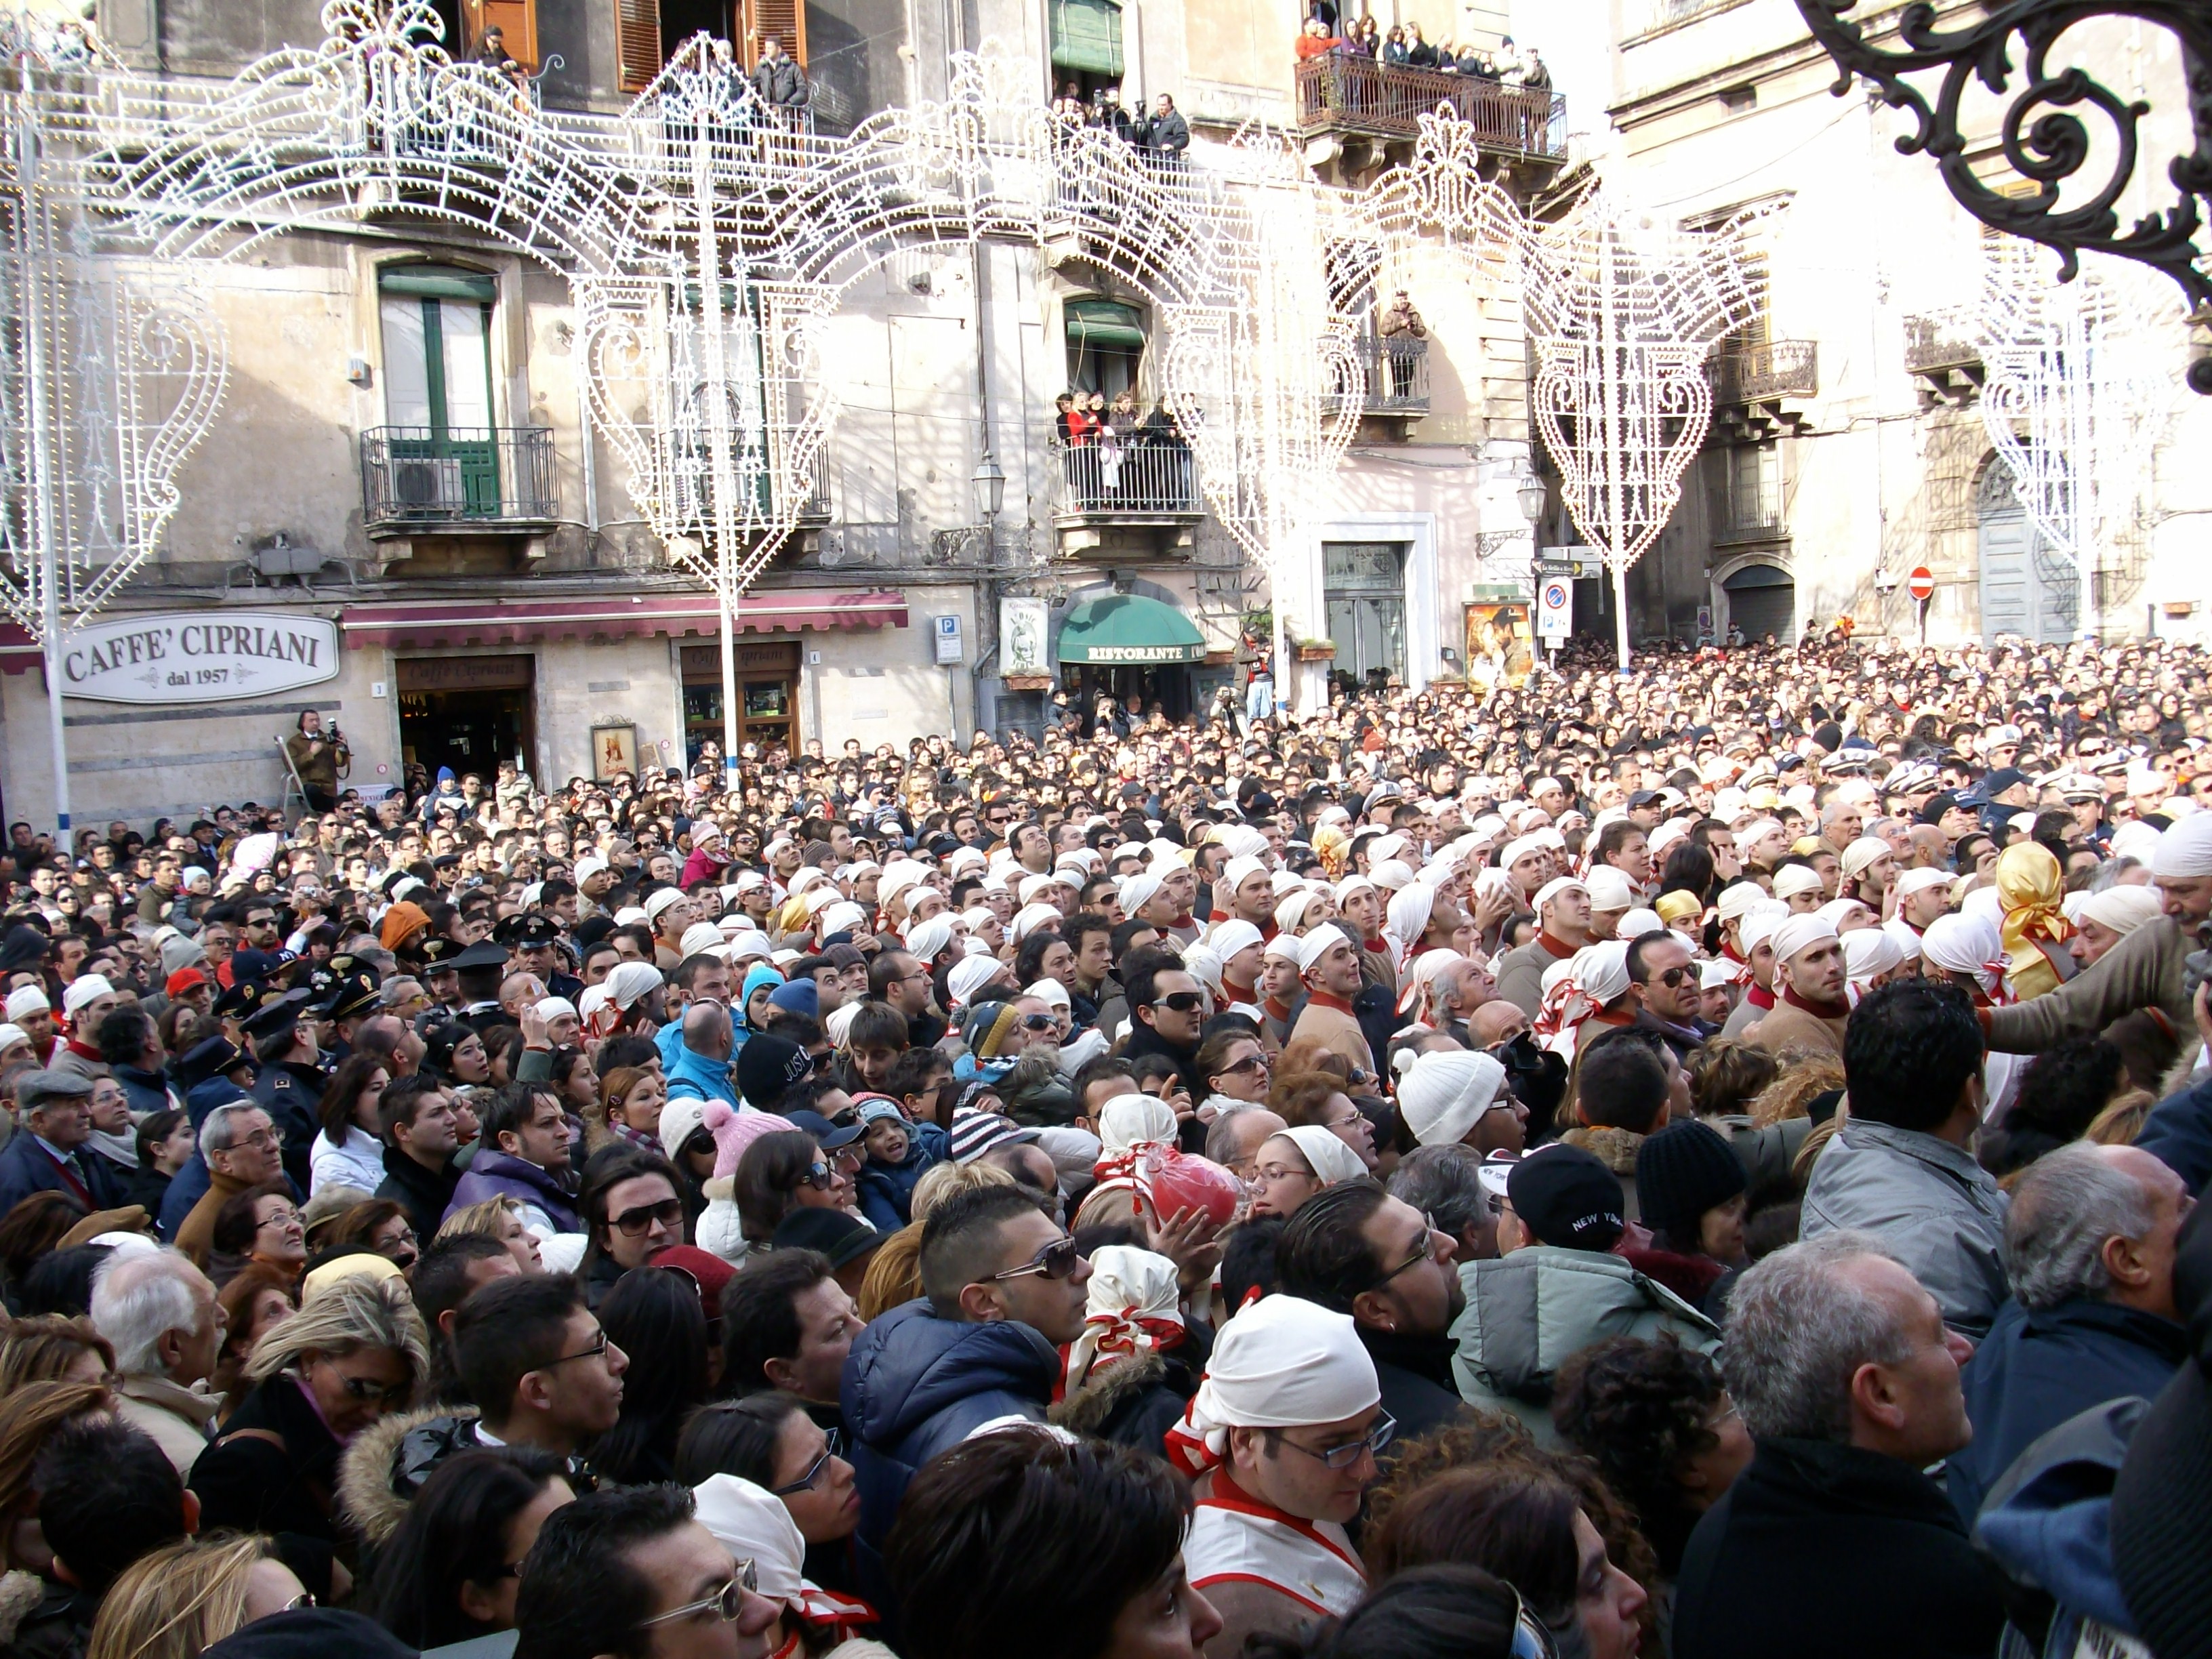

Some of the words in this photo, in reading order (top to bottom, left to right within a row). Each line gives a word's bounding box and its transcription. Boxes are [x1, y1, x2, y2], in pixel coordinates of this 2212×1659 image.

[943, 619, 953, 632] P
[65, 628, 173, 683] CAFFE'
[181, 625, 320, 668] CIPRIANI
[1088, 647, 1183, 661] RISTORANTE
[167, 669, 190, 687] dal
[195, 668, 229, 684] 1957
[783, 1052, 805, 1081] JUST
[1572, 1212, 1597, 1232] NEW
